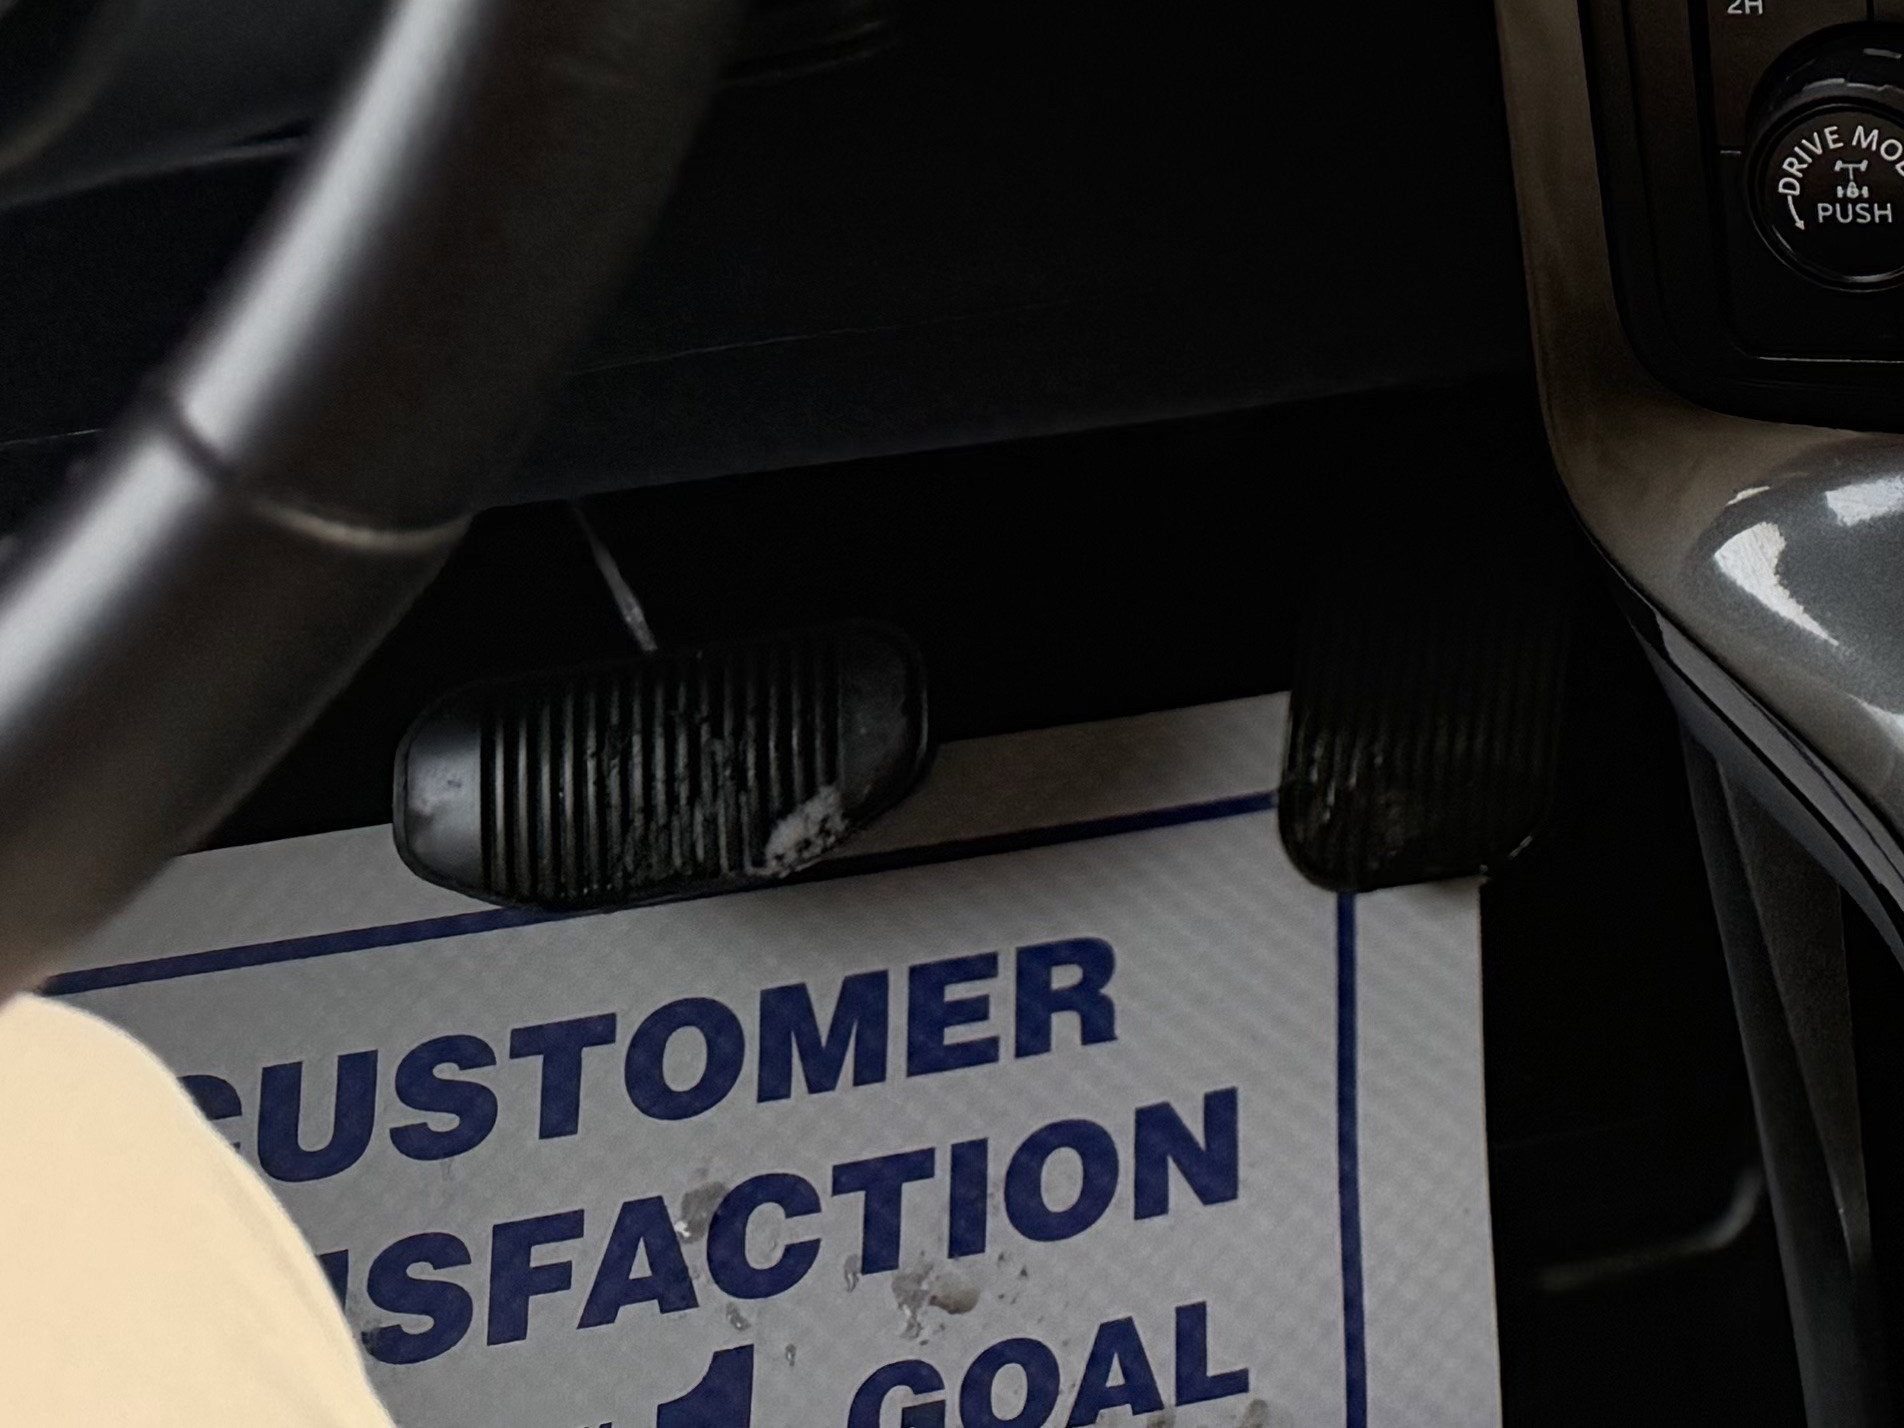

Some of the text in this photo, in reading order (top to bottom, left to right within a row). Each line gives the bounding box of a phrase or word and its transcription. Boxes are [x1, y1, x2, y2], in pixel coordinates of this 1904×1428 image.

[1778, 125, 1845, 197] DRIVE
[1816, 202, 1893, 224] PUSH
[316, 1085, 1242, 1365] SFACTION
[847, 1300, 1252, 1428] GOAL
